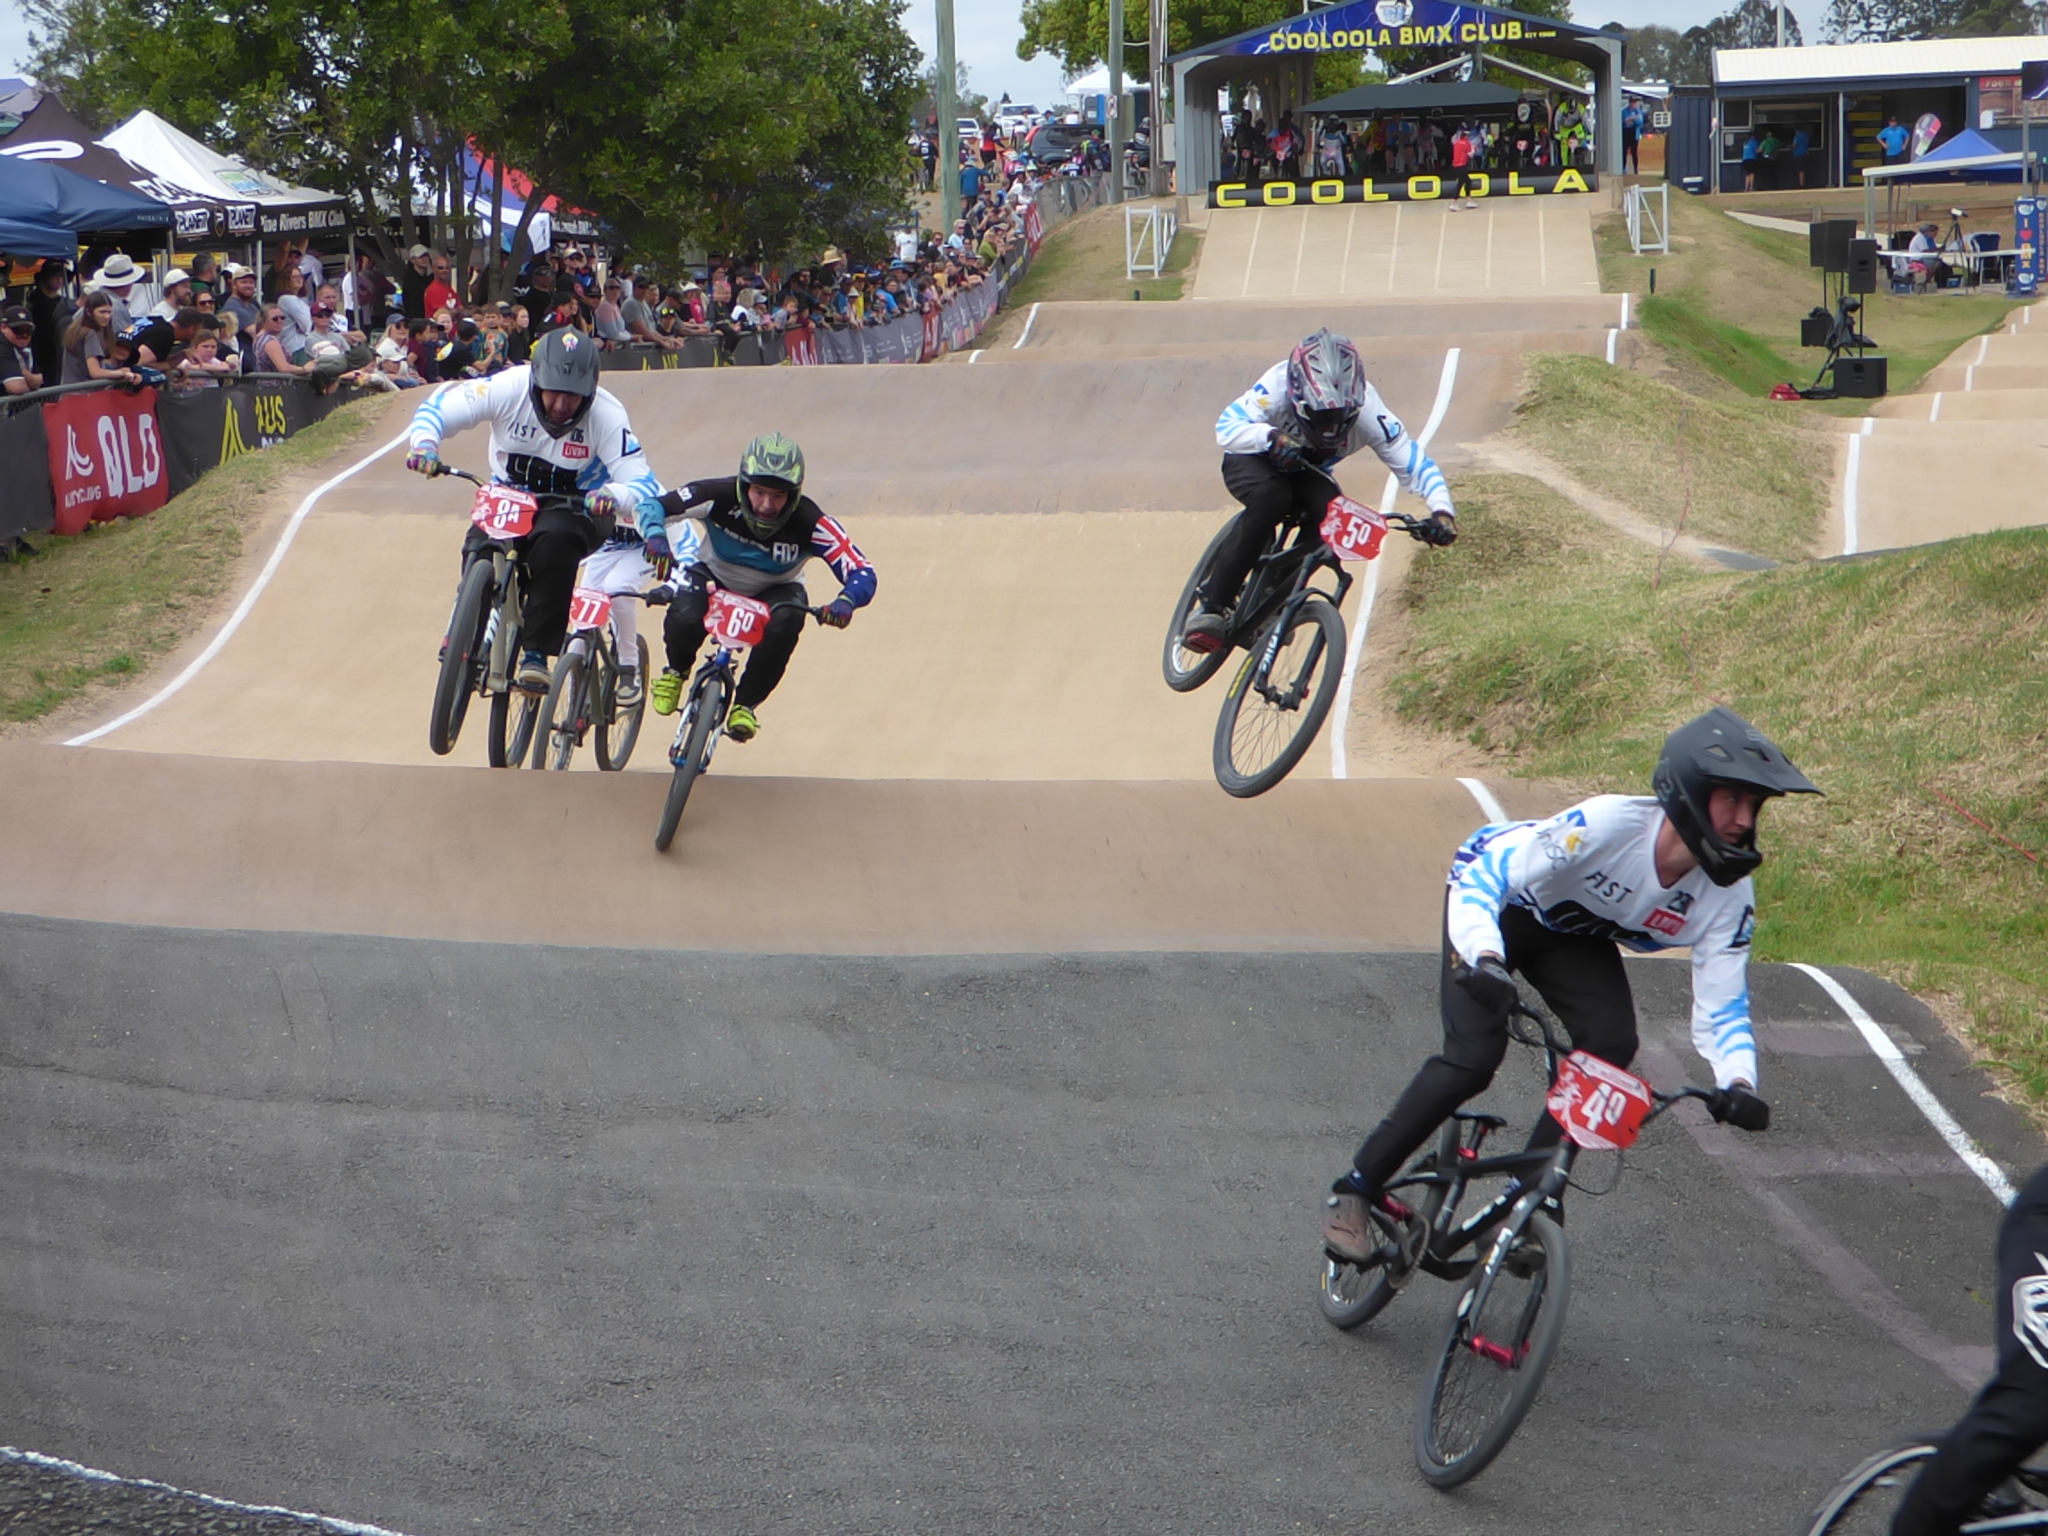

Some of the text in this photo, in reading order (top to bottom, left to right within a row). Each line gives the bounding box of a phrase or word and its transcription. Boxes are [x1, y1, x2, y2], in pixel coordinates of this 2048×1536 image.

[1269, 28, 1392, 51] COOLOOLA
[1401, 24, 1451, 46] BMX
[1460, 20, 1522, 41] CLUB
[1216, 168, 1590, 208] COOLOOLA
[280, 212, 307, 231] Rivers
[308, 210, 328, 229] BMX
[255, 395, 286, 435] AUS
[97, 413, 160, 499] QLD
[577, 597, 603, 624] 77
[1585, 870, 1634, 905] FIST
